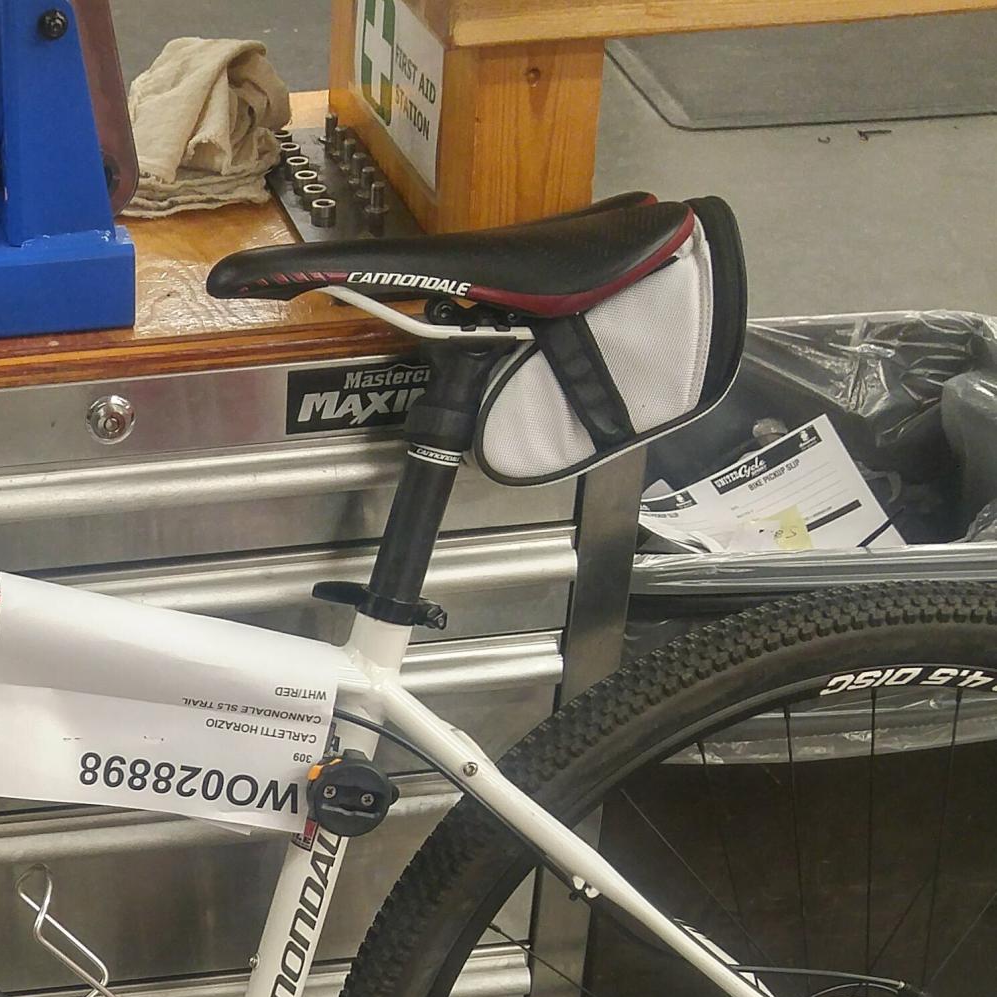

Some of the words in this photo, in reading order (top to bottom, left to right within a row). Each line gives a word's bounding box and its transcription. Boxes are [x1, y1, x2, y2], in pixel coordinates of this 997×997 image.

[395, 44, 418, 85] FIRST
[418, 72, 437, 104] AID
[395, 83, 430, 140] STATION
[347, 271, 471, 296] CANNONDALE
[738, 456, 766, 478] Cycle
[748, 479, 763, 491] BIKE
[763, 468, 785, 484] PICKUP
[786, 458, 800, 471] SLIP
[819, 667, 923, 695] DISC
[920, 667, 994, 688] 4.5
[182, 697, 214, 709] TRAIL
[275, 686, 327, 700] WHT/RED
[217, 702, 239, 712] SL5
[241, 705, 322, 724] CANNONDALE
[206, 718, 258, 735] HORAZIO
[260, 727, 317, 744] CARLETTI
[293, 752, 313, 764] 309
[79, 751, 299, 814] WO028898
